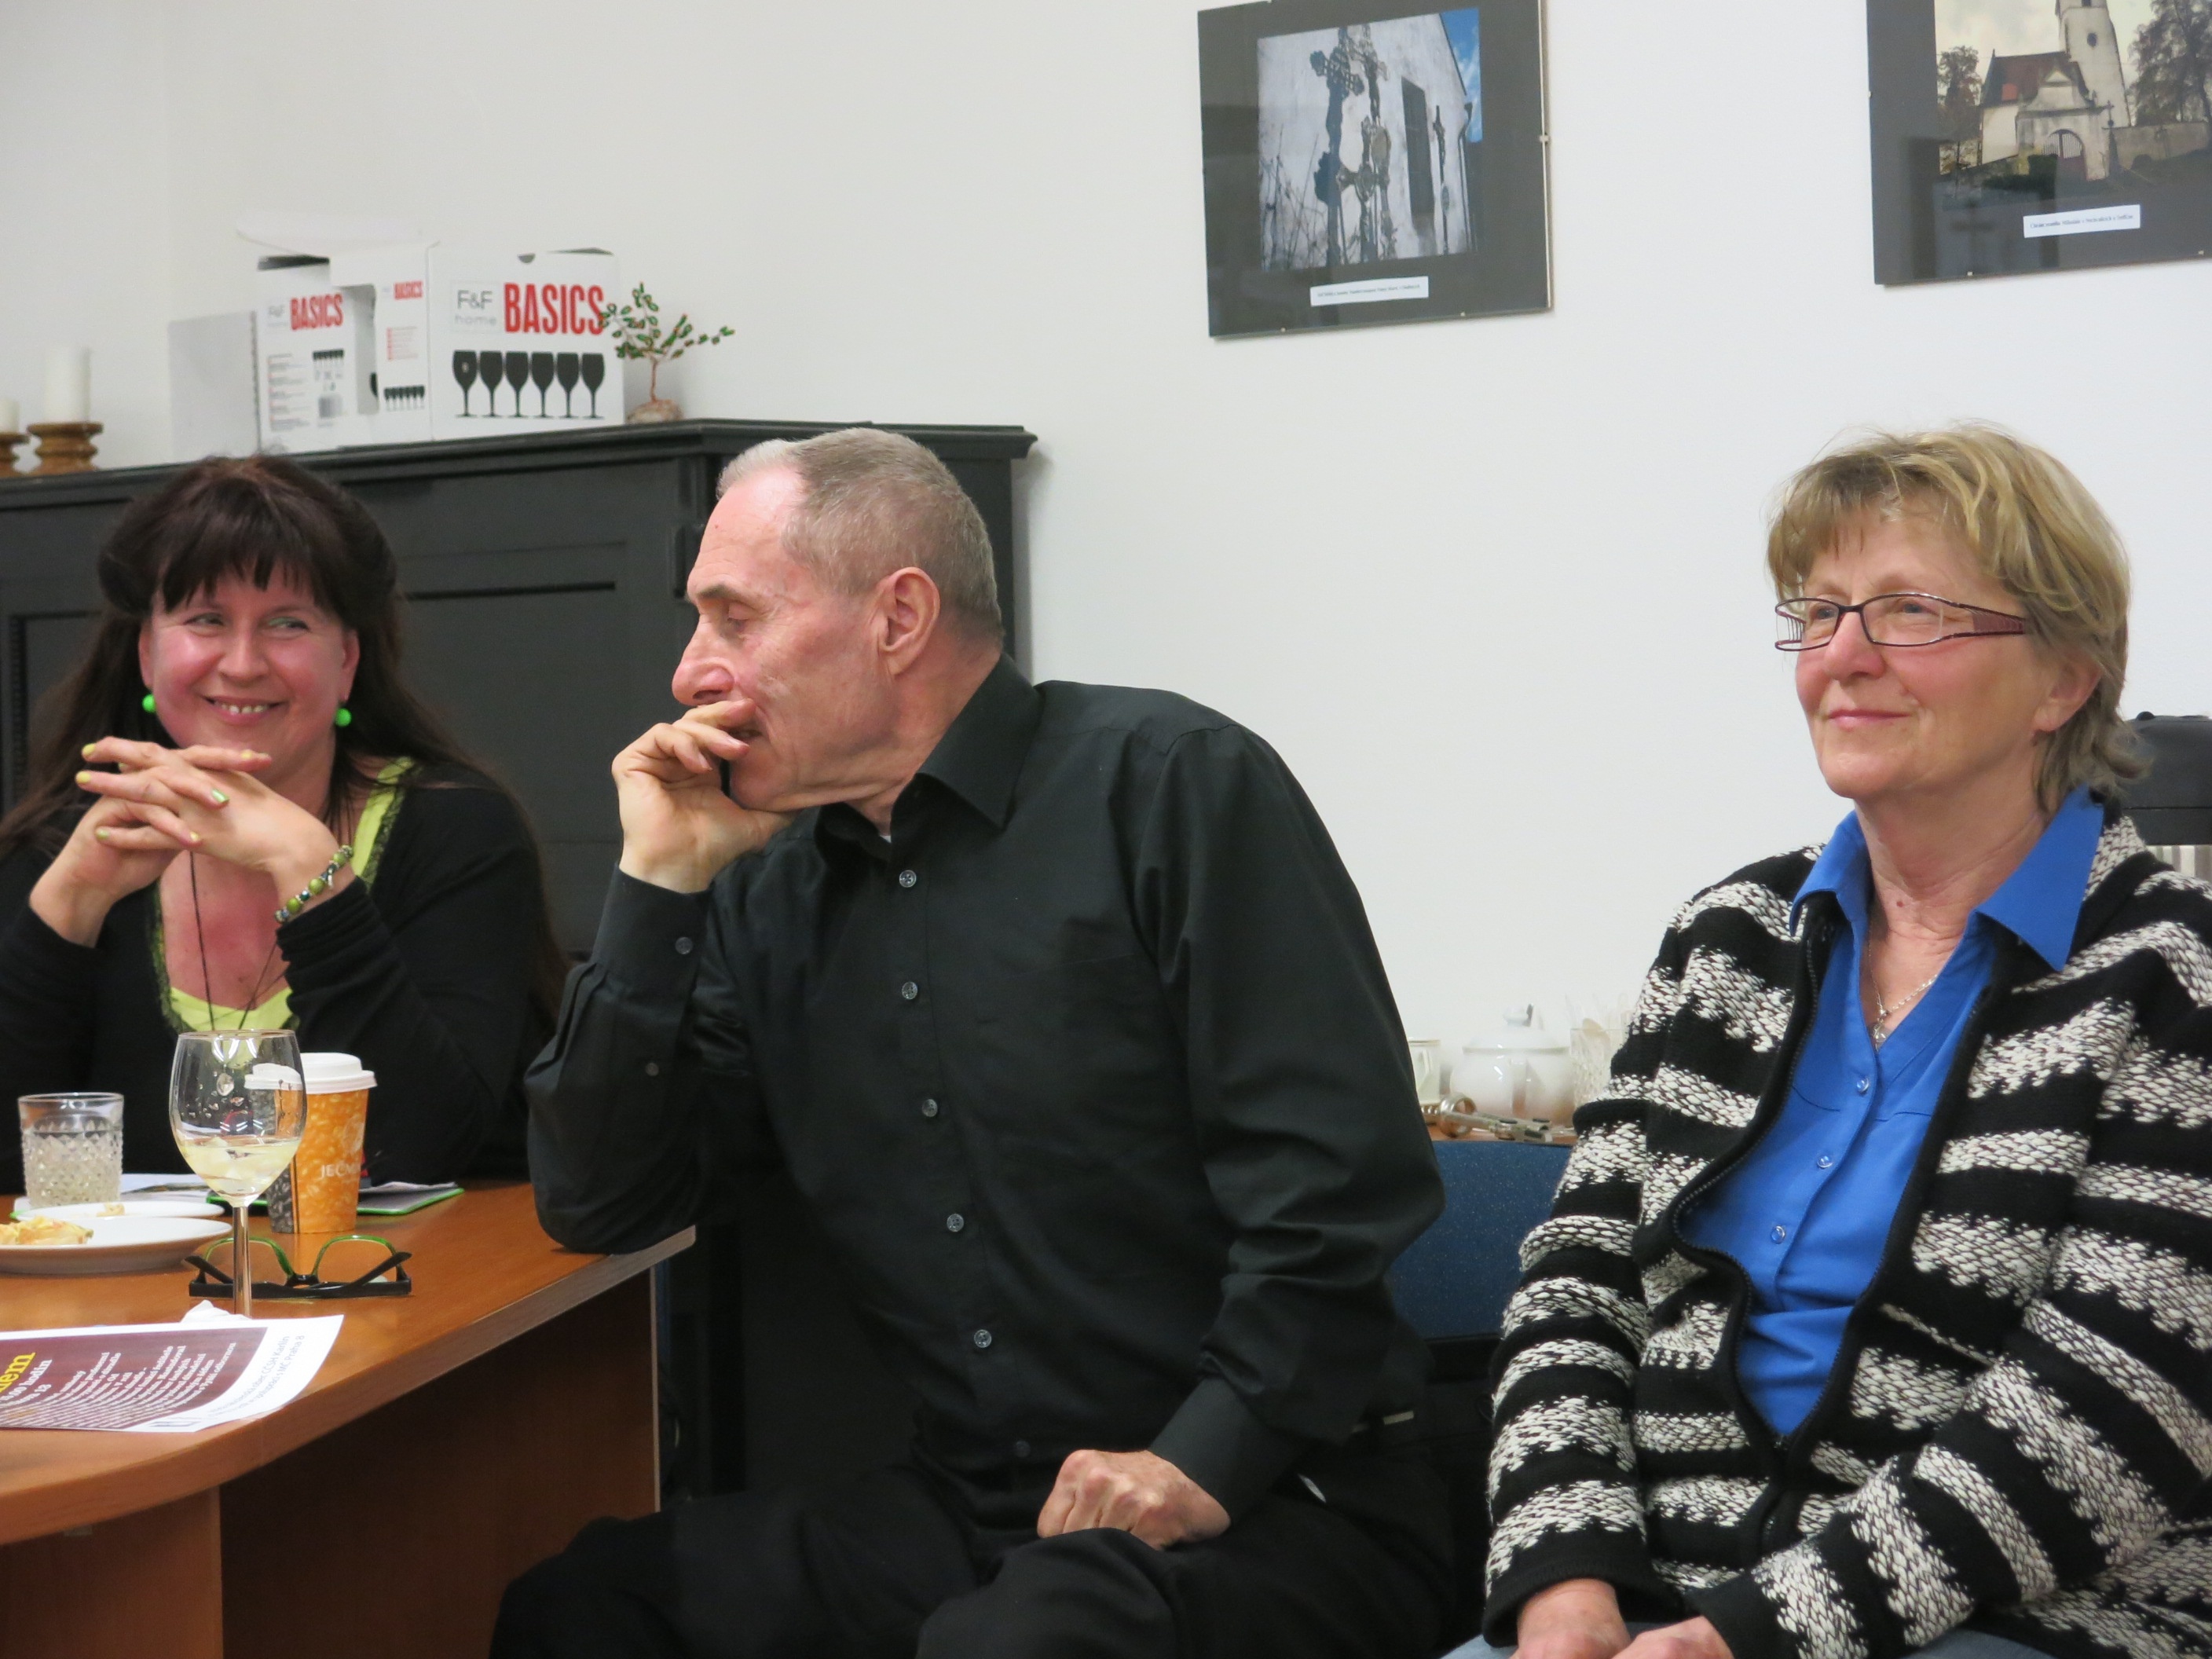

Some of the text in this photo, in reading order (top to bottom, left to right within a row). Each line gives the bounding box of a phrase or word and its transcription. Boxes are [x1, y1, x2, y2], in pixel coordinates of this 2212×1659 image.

[394, 280, 423, 299] BASICS
[290, 294, 343, 330] BASICS
[457, 283, 603, 335] F&F BASICS
[284, 1342, 302, 1360] Praha
[19, 1359, 53, 1386] hodin
